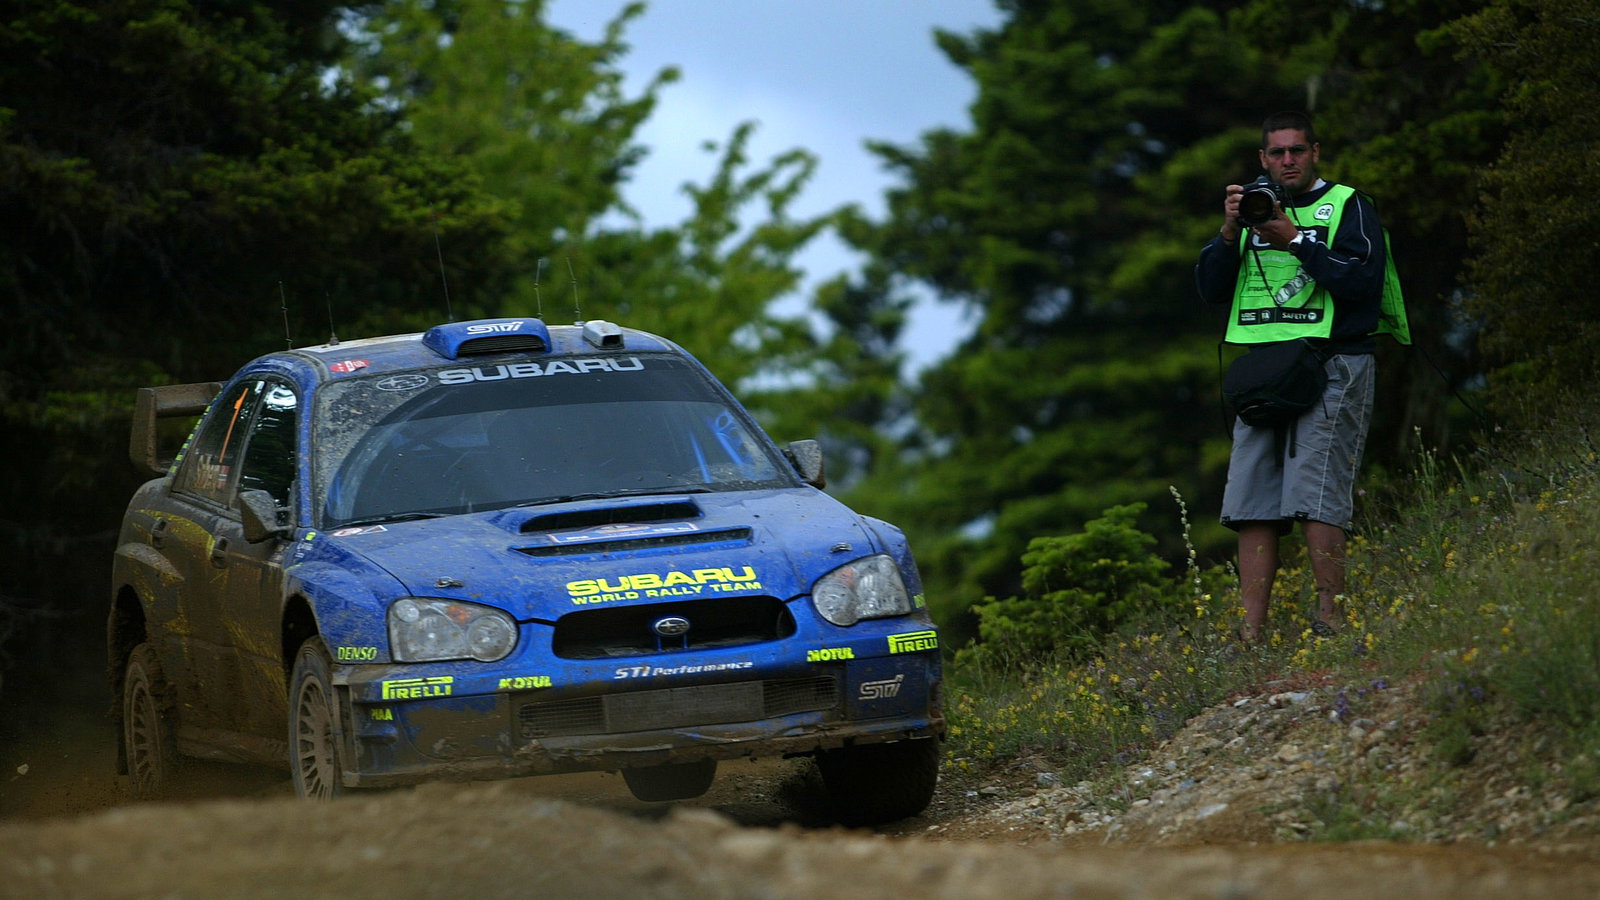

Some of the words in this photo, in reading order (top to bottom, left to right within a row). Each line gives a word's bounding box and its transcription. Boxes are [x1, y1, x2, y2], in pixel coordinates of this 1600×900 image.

[1281, 312, 1307, 320] SAFETY
[437, 357, 646, 385] SUBARU
[566, 566, 757, 597] SUBARU
[571, 591, 640, 606] WORLD
[646, 585, 703, 598] RALLY
[709, 581, 762, 593] TEAM
[337, 647, 377, 660] DENSO
[887, 630, 938, 654] PIRELLI
[806, 647, 855, 662] MOTUL
[653, 660, 753, 677] Performance
[382, 676, 454, 700] PIRELLI
